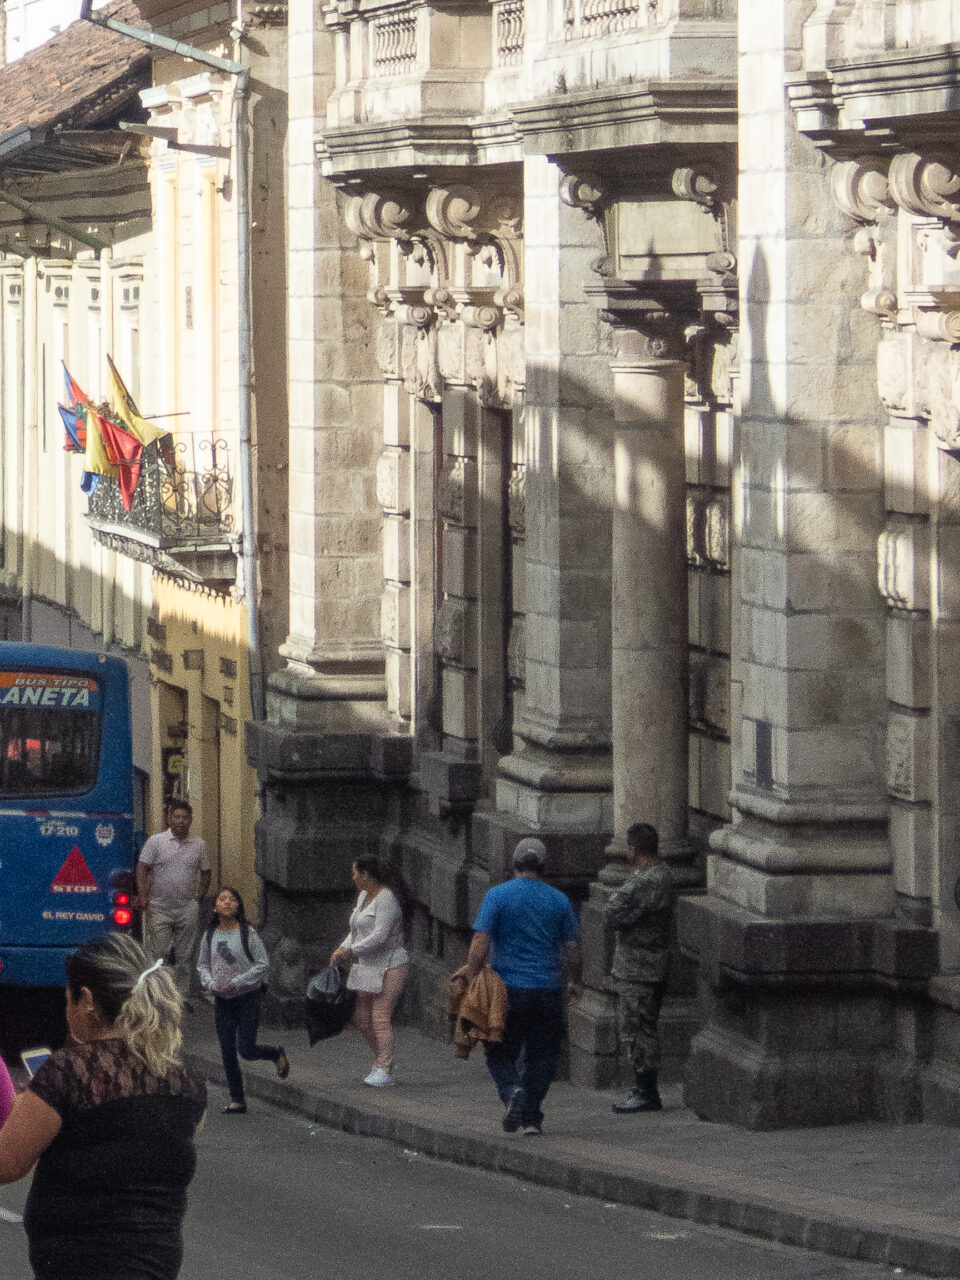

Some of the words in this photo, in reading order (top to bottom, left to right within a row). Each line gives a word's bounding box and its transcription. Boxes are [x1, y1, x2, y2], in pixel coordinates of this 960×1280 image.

[14, 678, 47, 686] BUS
[52, 679, 89, 687] TIPO
[52, 885, 98, 893] STOP
[42, 911, 54, 919] EL
[55, 911, 75, 920] REY
[76, 913, 105, 921] DAVID
